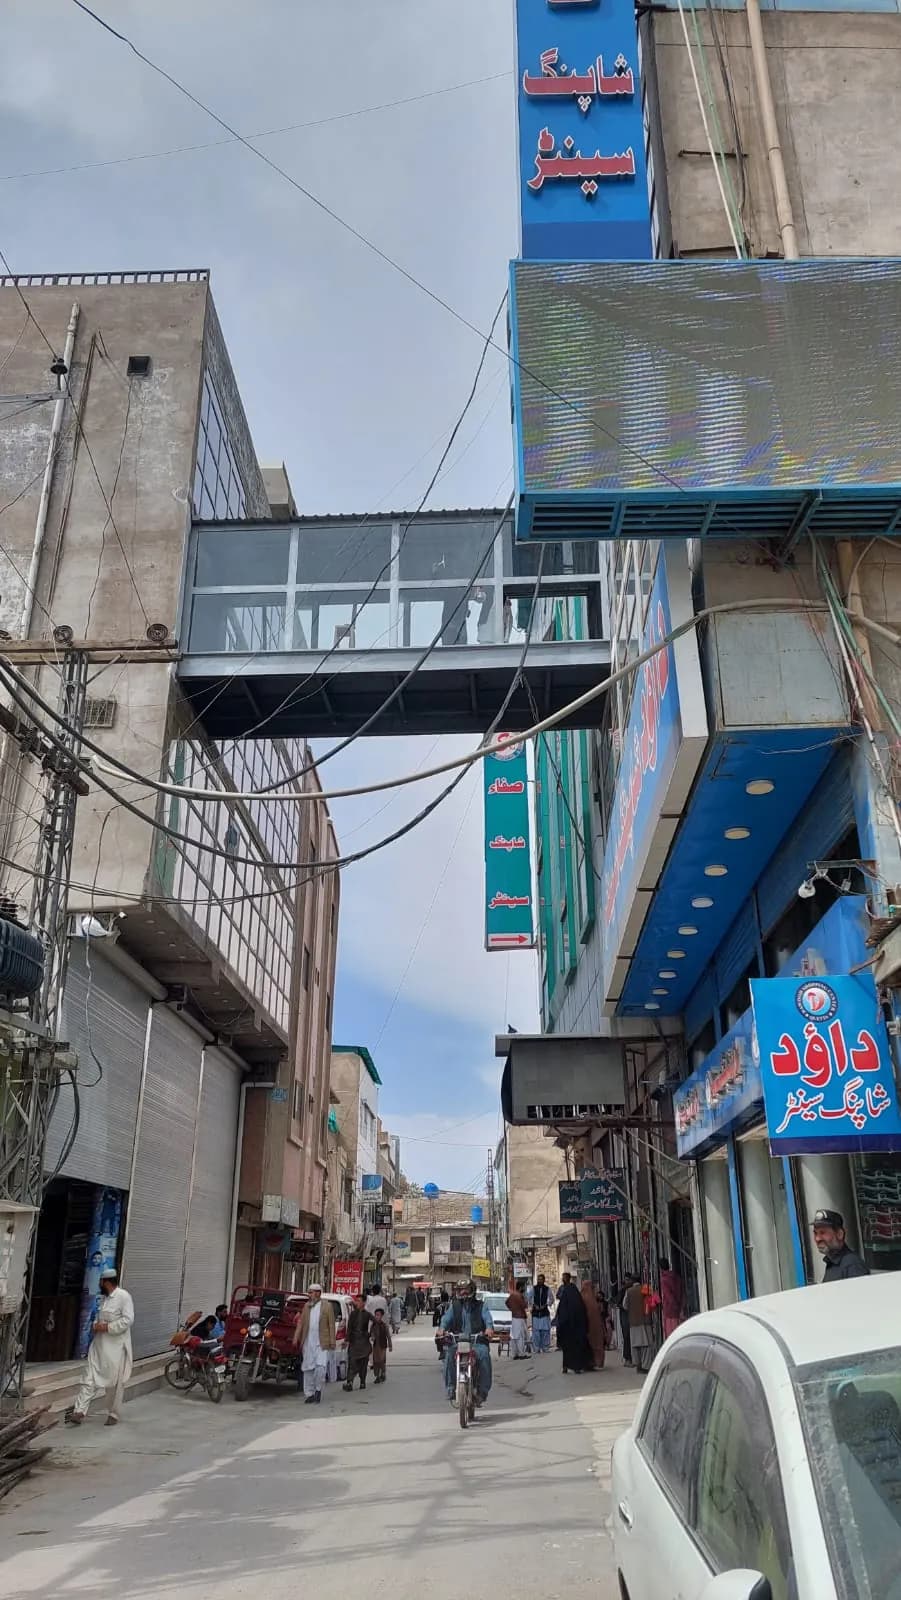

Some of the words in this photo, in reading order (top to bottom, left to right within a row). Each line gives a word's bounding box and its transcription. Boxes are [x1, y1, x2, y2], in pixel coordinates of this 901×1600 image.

[523, 47, 634, 112] شاپنگ
[527, 127, 636, 194] سینٹر
[770, 1020, 880, 1087] داؤد
[775, 1088, 824, 1133] سینٹر
[820, 1077, 891, 1129] شاپنگ
